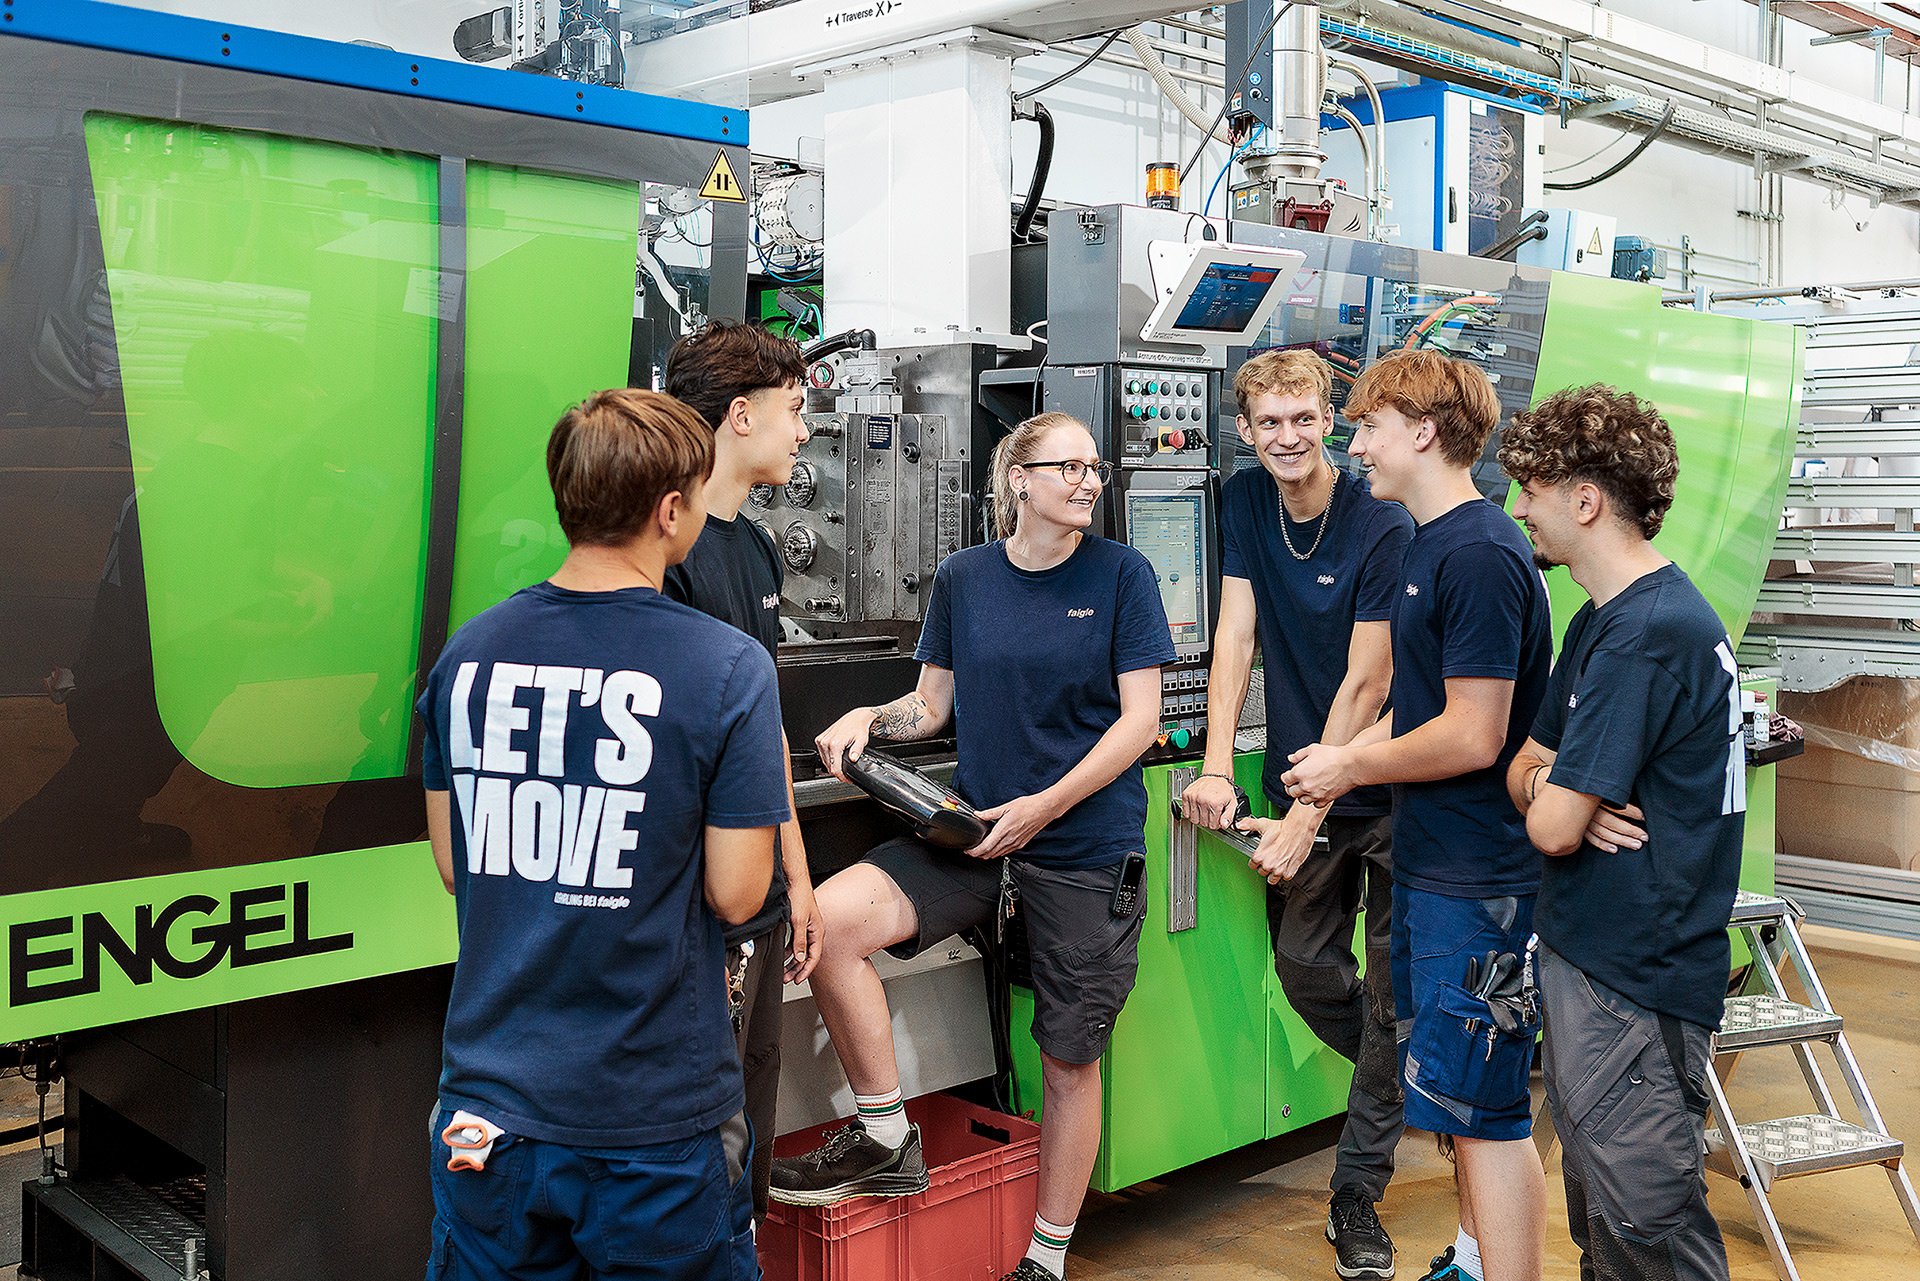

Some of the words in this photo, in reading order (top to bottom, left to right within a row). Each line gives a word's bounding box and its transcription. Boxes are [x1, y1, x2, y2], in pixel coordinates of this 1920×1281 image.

[841, 8, 874, 23] Traverse
[875, 0, 885, 17] X
[1176, 475, 1204, 487] ENGEL
[449, 661, 663, 786] LET'S
[452, 773, 647, 889] MOVE
[596, 895, 631, 910] faigle
[8, 880, 354, 1009] ENGEL
